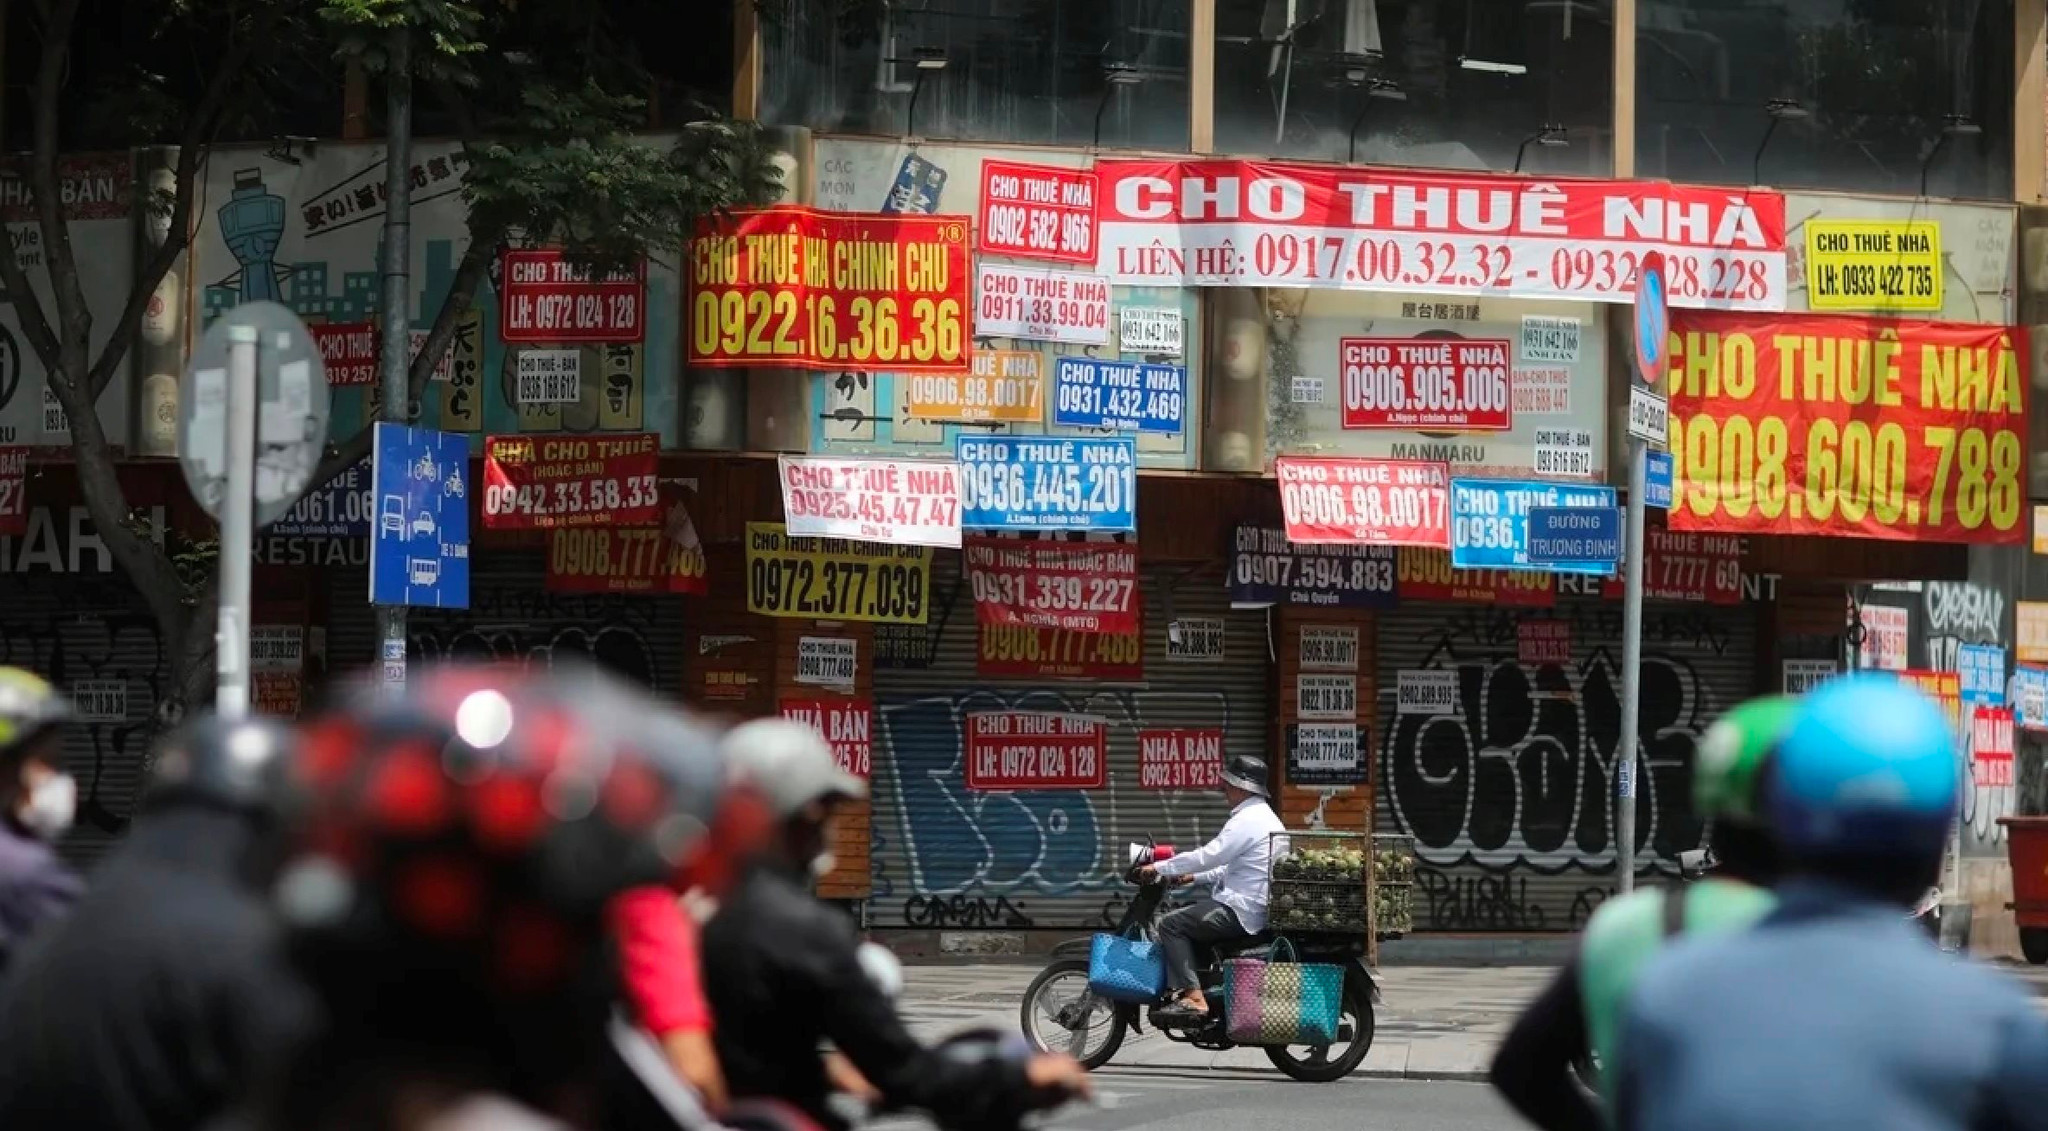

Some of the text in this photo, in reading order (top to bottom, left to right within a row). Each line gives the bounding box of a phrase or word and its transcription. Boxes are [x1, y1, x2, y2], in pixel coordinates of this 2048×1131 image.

[990, 174, 1093, 208] CHO THUÊ NHÀ
[1115, 175, 1767, 248] CHO THUÊ NHÀ
[988, 204, 1090, 254] 0902 582 966
[1817, 230, 1931, 253] CHO THUÊ NHÀ
[512, 261, 546, 282] CHO
[694, 223, 949, 293] CHO THUÊ NHÀ CHÍNH CHỦ
[1117, 238, 1187, 276] LIÊN
[1195, 239, 1246, 283] HỆ:
[1255, 232, 1513, 289] 0917.00.32.32
[1552, 247, 1768, 301] 093228.228
[982, 273, 1108, 303] CHO THUÊ NHÀ
[1817, 264, 1932, 297] LH: 0933 422 735
[509, 294, 635, 329] LH: 0972 024 128
[694, 290, 961, 362] 0922.16.36.36
[981, 294, 1106, 329] 0911.33.99.04
[319, 325, 373, 360] CHO THUÊ
[1346, 343, 1506, 365] CHO THUÊ NHÀ
[353, 365, 374, 382] 257
[973, 352, 1038, 378] UÊ NHÀ
[1061, 361, 1181, 391] CHO THUÊ NHÀ
[1773, 329, 1903, 406] THUÊ
[1921, 335, 2023, 414] NHÀ
[912, 375, 1039, 407] 0906.98.0017
[1059, 384, 1180, 421] 0931.432.469
[1346, 365, 1506, 412] 0906.905.006
[493, 436, 653, 464] NHÀ CHO THUÊ
[961, 442, 1131, 464] CHO THUÊ NHÀ
[1391, 443, 1485, 462] MANMARU
[787, 465, 957, 495] CHO THUÊ NHÀ
[962, 462, 1134, 513] 0936.445.201
[1282, 463, 1445, 487] CHO THUÊ NHÀ
[0, 479, 25, 515] 27
[485, 475, 659, 516] 0942.33.58.33
[791, 487, 958, 528] 0925.45.47.47
[1284, 482, 1446, 530] 0906.98.0017
[1456, 487, 1499, 517] CHO
[1548, 512, 1601, 530] ĐƯỜNG
[250, 537, 369, 566] ESTAU
[753, 532, 779, 550] CHO
[1532, 537, 1617, 559] TRƯƠNG ĐỊNH
[967, 545, 994, 566] CHO
[1106, 549, 1136, 574] BÁN
[1236, 553, 1394, 593] 0907.594.883
[1715, 559, 1740, 592] 69
[751, 557, 923, 618] 0972.377.039
[971, 569, 1134, 612] 0931.339.227
[829, 702, 870, 742] BÁN
[976, 717, 1009, 735] CHO
[855, 743, 870, 775] 78
[975, 745, 1096, 778] LH: 0972 024 128
[1142, 731, 1220, 762] NHÀ BÁN
[1142, 763, 1171, 788] 0902
[1174, 763, 1187, 787] 31
[1190, 763, 1205, 787] 92
